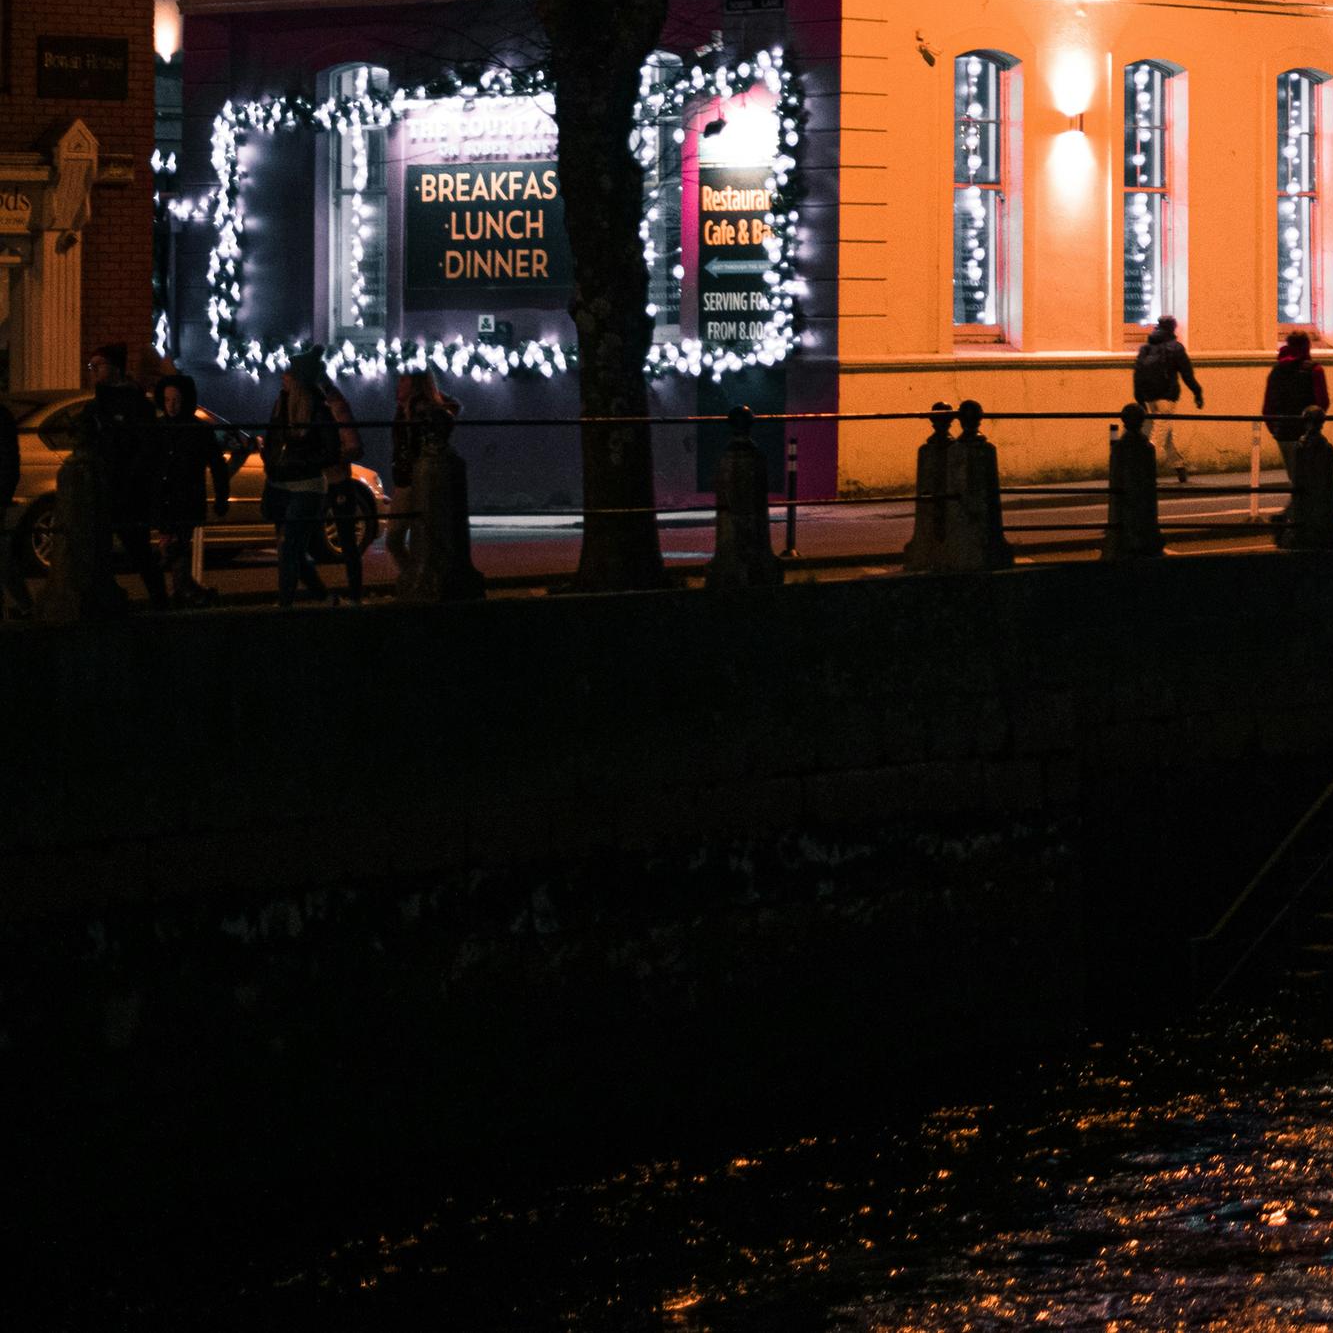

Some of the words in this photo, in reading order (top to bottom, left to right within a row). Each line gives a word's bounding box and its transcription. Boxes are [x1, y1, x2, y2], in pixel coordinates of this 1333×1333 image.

[421, 170, 558, 202] BREAKFAS
[702, 185, 771, 211] Restauran
[451, 210, 544, 240] LUNCH
[704, 219, 736, 245] Cafe
[737, 218, 750, 245] &
[751, 219, 775, 245] Ba
[445, 249, 549, 278] DINNER
[704, 292, 748, 311] SERVING
[750, 292, 777, 311] FO
[708, 321, 736, 340] FROM
[739, 321, 764, 340] 8.00
